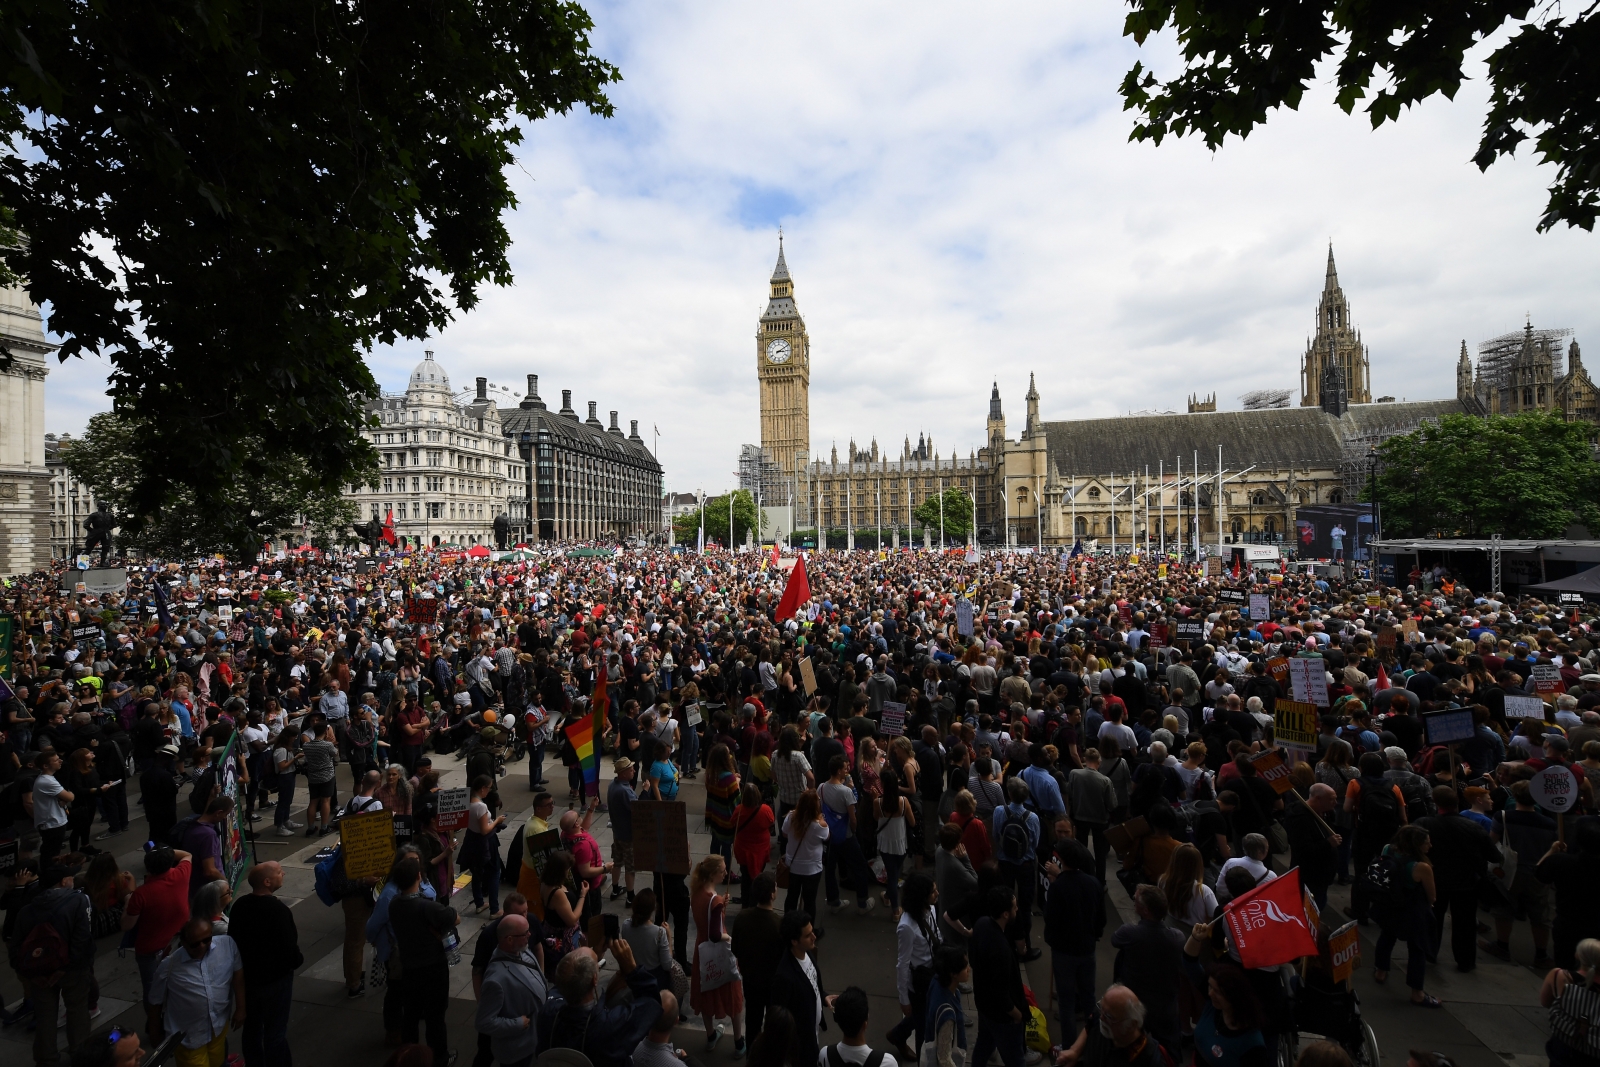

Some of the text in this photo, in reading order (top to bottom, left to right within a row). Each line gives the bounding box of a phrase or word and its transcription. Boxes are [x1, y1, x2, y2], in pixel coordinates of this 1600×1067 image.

[408, 599, 437, 607] END
[409, 607, 436, 615] TORY
[409, 615, 435, 624] RULE
[1271, 664, 1289, 673] OUT!
[1276, 700, 1316, 714] AUSTERITY
[1276, 710, 1316, 734] KILLS
[1276, 728, 1315, 744] AUSTERITY
[1263, 763, 1291, 781] OUT!
[1241, 910, 1252, 932] UNION
[1334, 941, 1358, 966] OUT!
